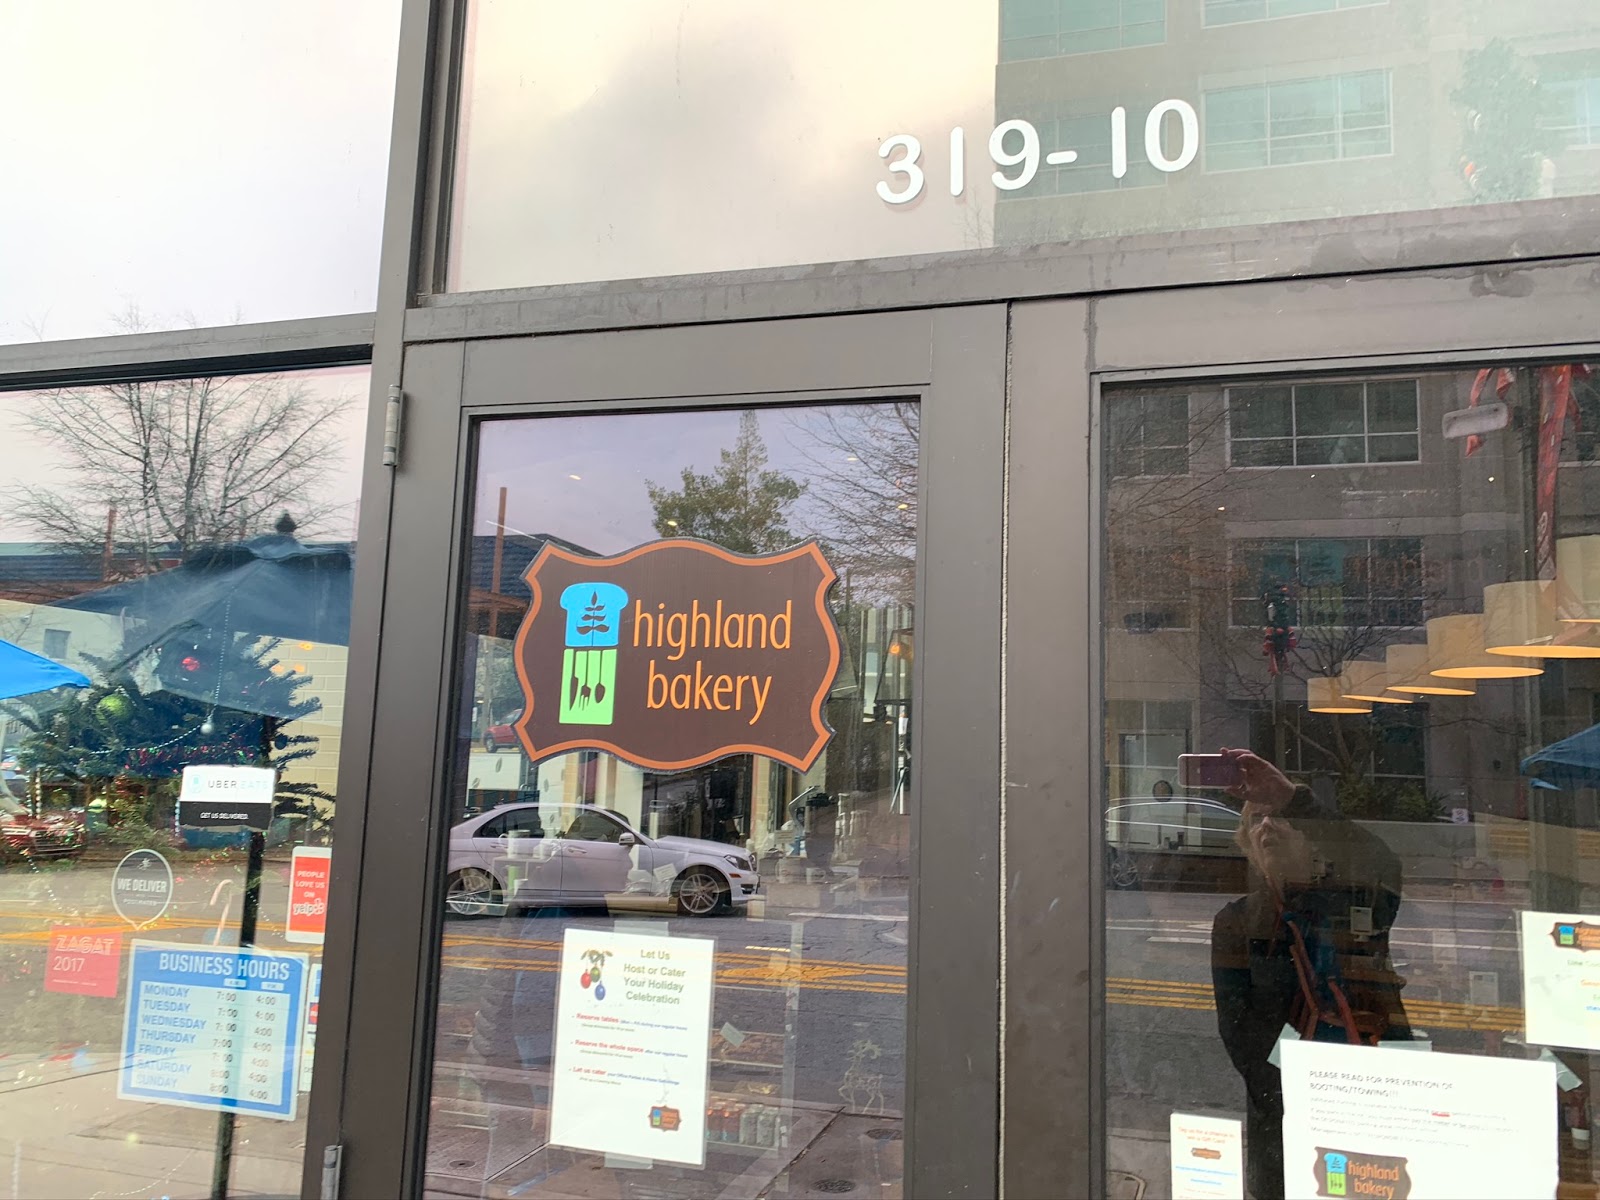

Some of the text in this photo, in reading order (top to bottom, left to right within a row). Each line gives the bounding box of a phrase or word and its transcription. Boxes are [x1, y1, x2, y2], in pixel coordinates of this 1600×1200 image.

[632, 600, 792, 660] highland
[647, 660, 772, 725] bakery
[208, 780, 237, 789] UBER
[297, 870, 325, 879] PEOPLE
[117, 878, 167, 893] WE DELIVER
[295, 881, 325, 889] LOVE US
[293, 901, 314, 917] yelp
[55, 934, 115, 956] ZAGAT
[641, 949, 670, 960] Let Us
[53, 955, 86, 972] 2017
[159, 952, 290, 981] BUSINESS HOURS
[624, 963, 686, 977] Host or Cater
[624, 977, 684, 993] Your Holiday
[143, 984, 277, 1006] MONDAY 7:00 4:00
[625, 991, 680, 1005] Celebration
[143, 999, 276, 1022] TUESDAY 7:00 4:00
[141, 1014, 207, 1030] WEDNESDAY
[254, 1026, 273, 1037] 4:00
[140, 1029, 272, 1053] THURSDAY 7:00 4:00
[138, 1044, 176, 1056] FRIDAY
[136, 1060, 192, 1074] SATURDAY
[135, 1074, 178, 1088] SUNDAY
[1309, 1070, 1338, 1079] PLEASE
[1341, 1072, 1363, 1082] READ
[1366, 1075, 1382, 1084] FOR
[1385, 1077, 1439, 1088] PREVENTION
[1347, 1160, 1400, 1181] highland
[1354, 1178, 1394, 1200] bakery
